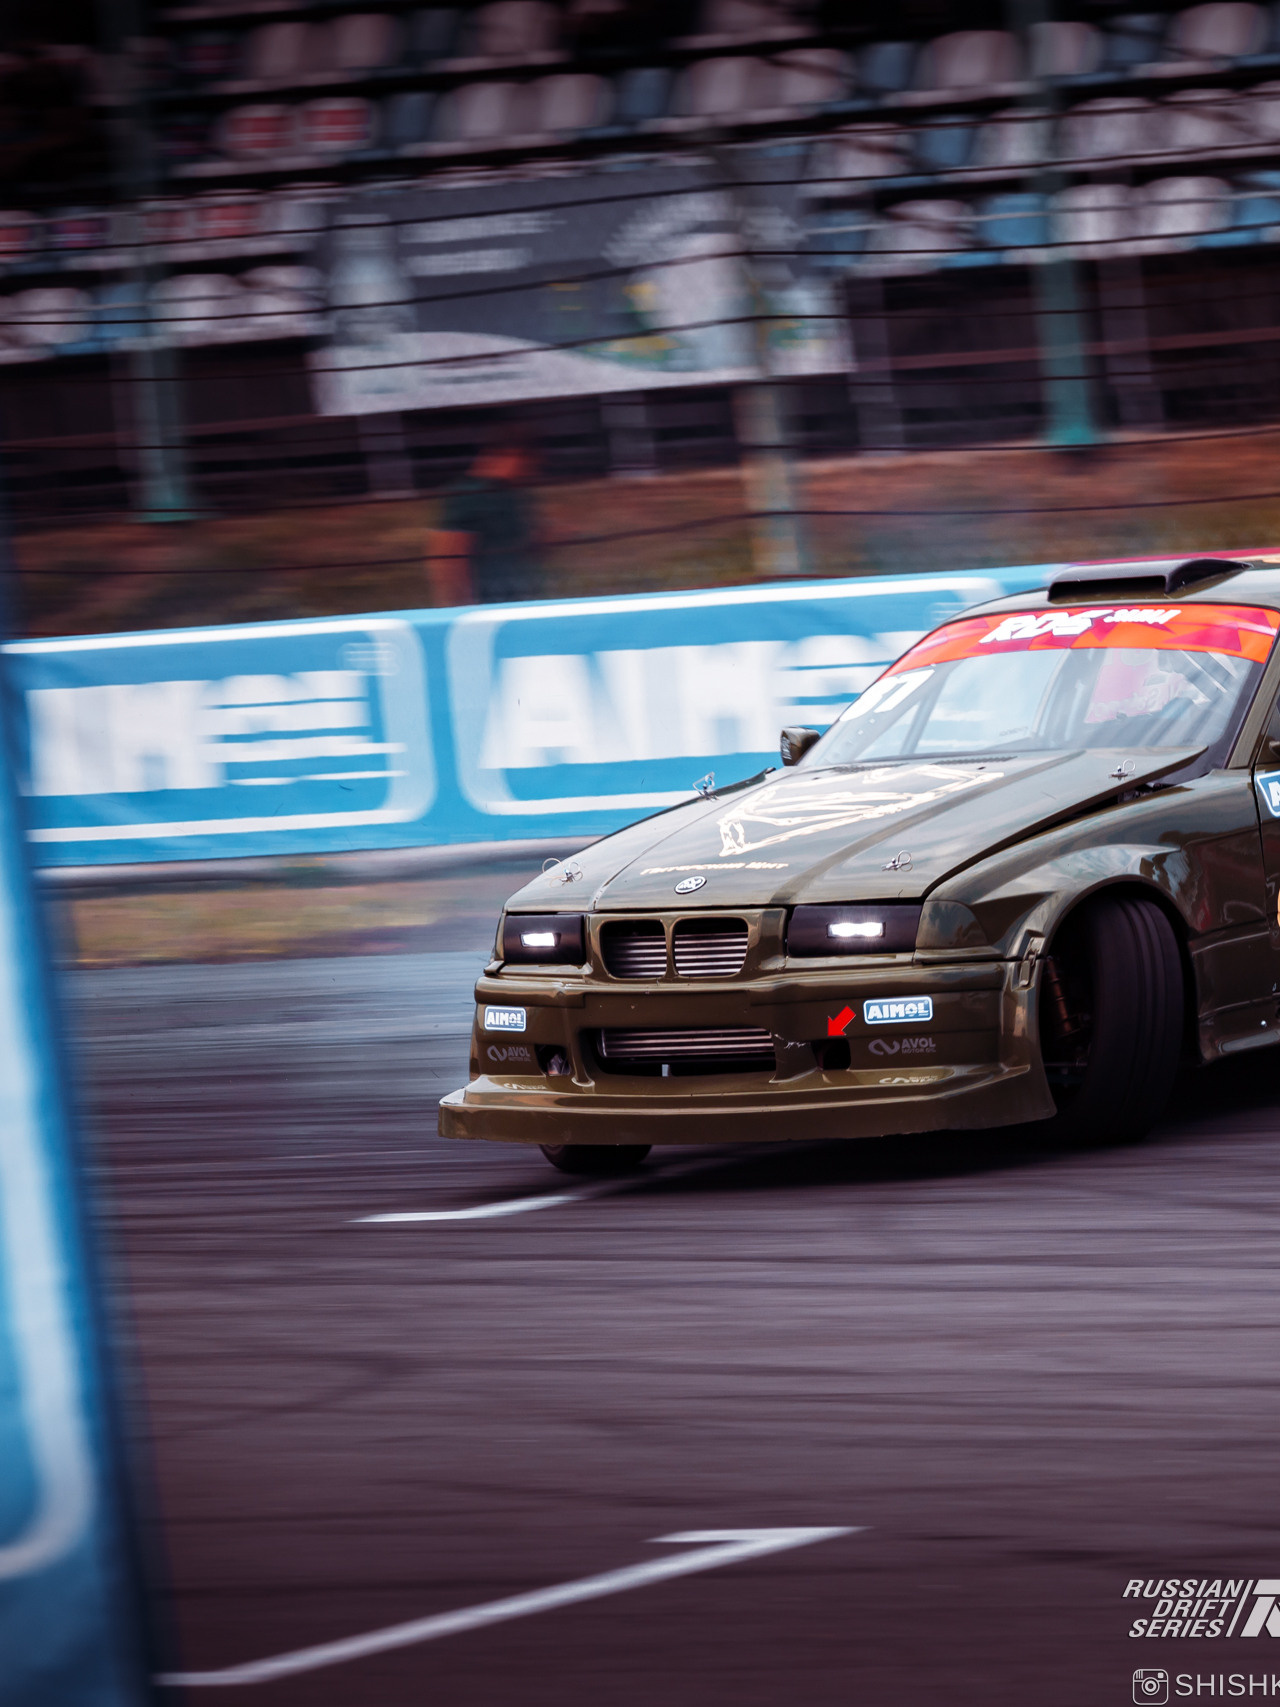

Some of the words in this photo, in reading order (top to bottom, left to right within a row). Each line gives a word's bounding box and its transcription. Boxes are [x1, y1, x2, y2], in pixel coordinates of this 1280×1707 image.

[979, 611, 1114, 643] RDS
[867, 1002, 930, 1019] AIMOL
[487, 1011, 524, 1026] AIMOL
[902, 1037, 936, 1050] AVOL
[508, 1046, 530, 1057] AVOL
